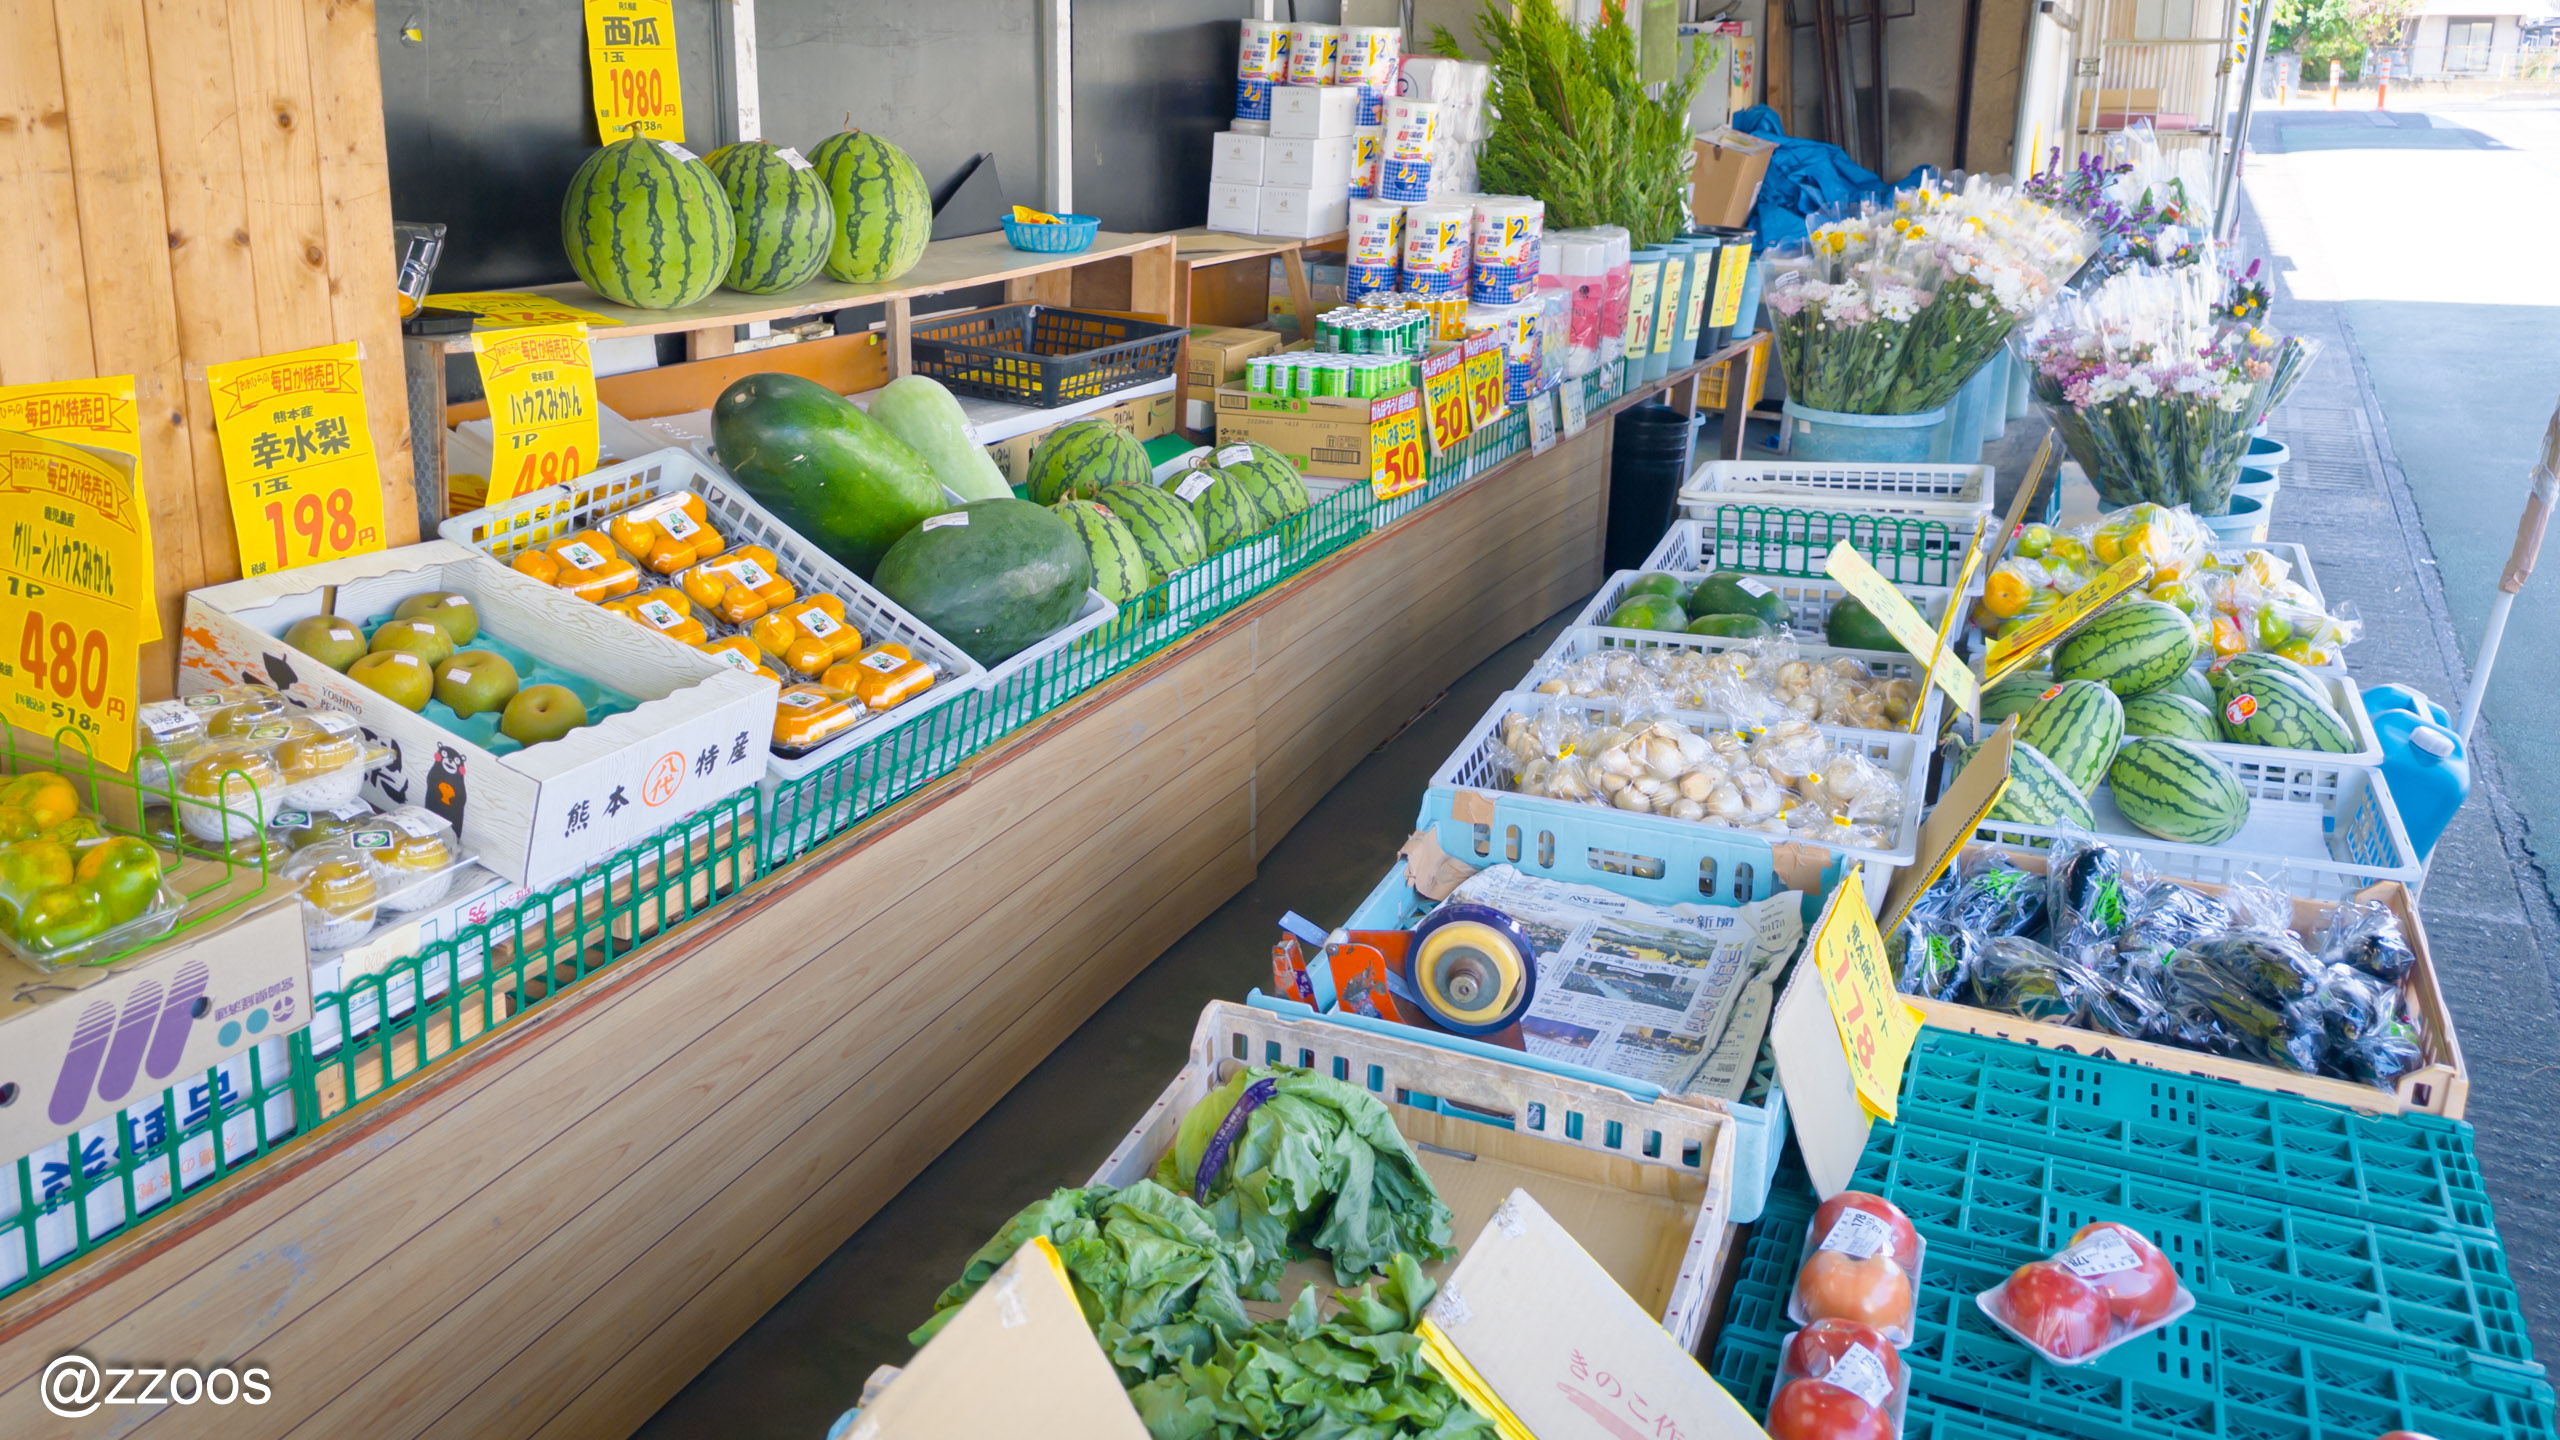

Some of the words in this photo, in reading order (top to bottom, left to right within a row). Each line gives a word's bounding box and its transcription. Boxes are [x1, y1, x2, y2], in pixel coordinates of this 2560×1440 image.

[602, 16, 661, 46] 西瓜
[603, 51, 626, 63] 1玉
[1512, 217, 1526, 239] 2
[1525, 316, 1536, 337] 2
[510, 385, 583, 426] ハウスみかん
[1475, 376, 1500, 424] 50
[273, 405, 314, 425] 熊本産
[1435, 397, 1463, 448] 50
[250, 415, 351, 470] 幸水梨
[511, 433, 538, 450] 1P
[1384, 441, 1420, 494] 50
[252, 475, 292, 498] 1玉
[44, 506, 76, 528] 鹿児島産
[12, 521, 114, 596] グリーンハウスみかん
[7, 576, 45, 599] 1P
[322, 687, 363, 715] YOSHINO
[565, 785, 630, 838] 熊本
[649, 756, 680, 802] 八代
[695, 730, 749, 779] 特産
[214, 976, 295, 1022] 宮崎県経済連
[1850, 1213, 1867, 1228] 178
